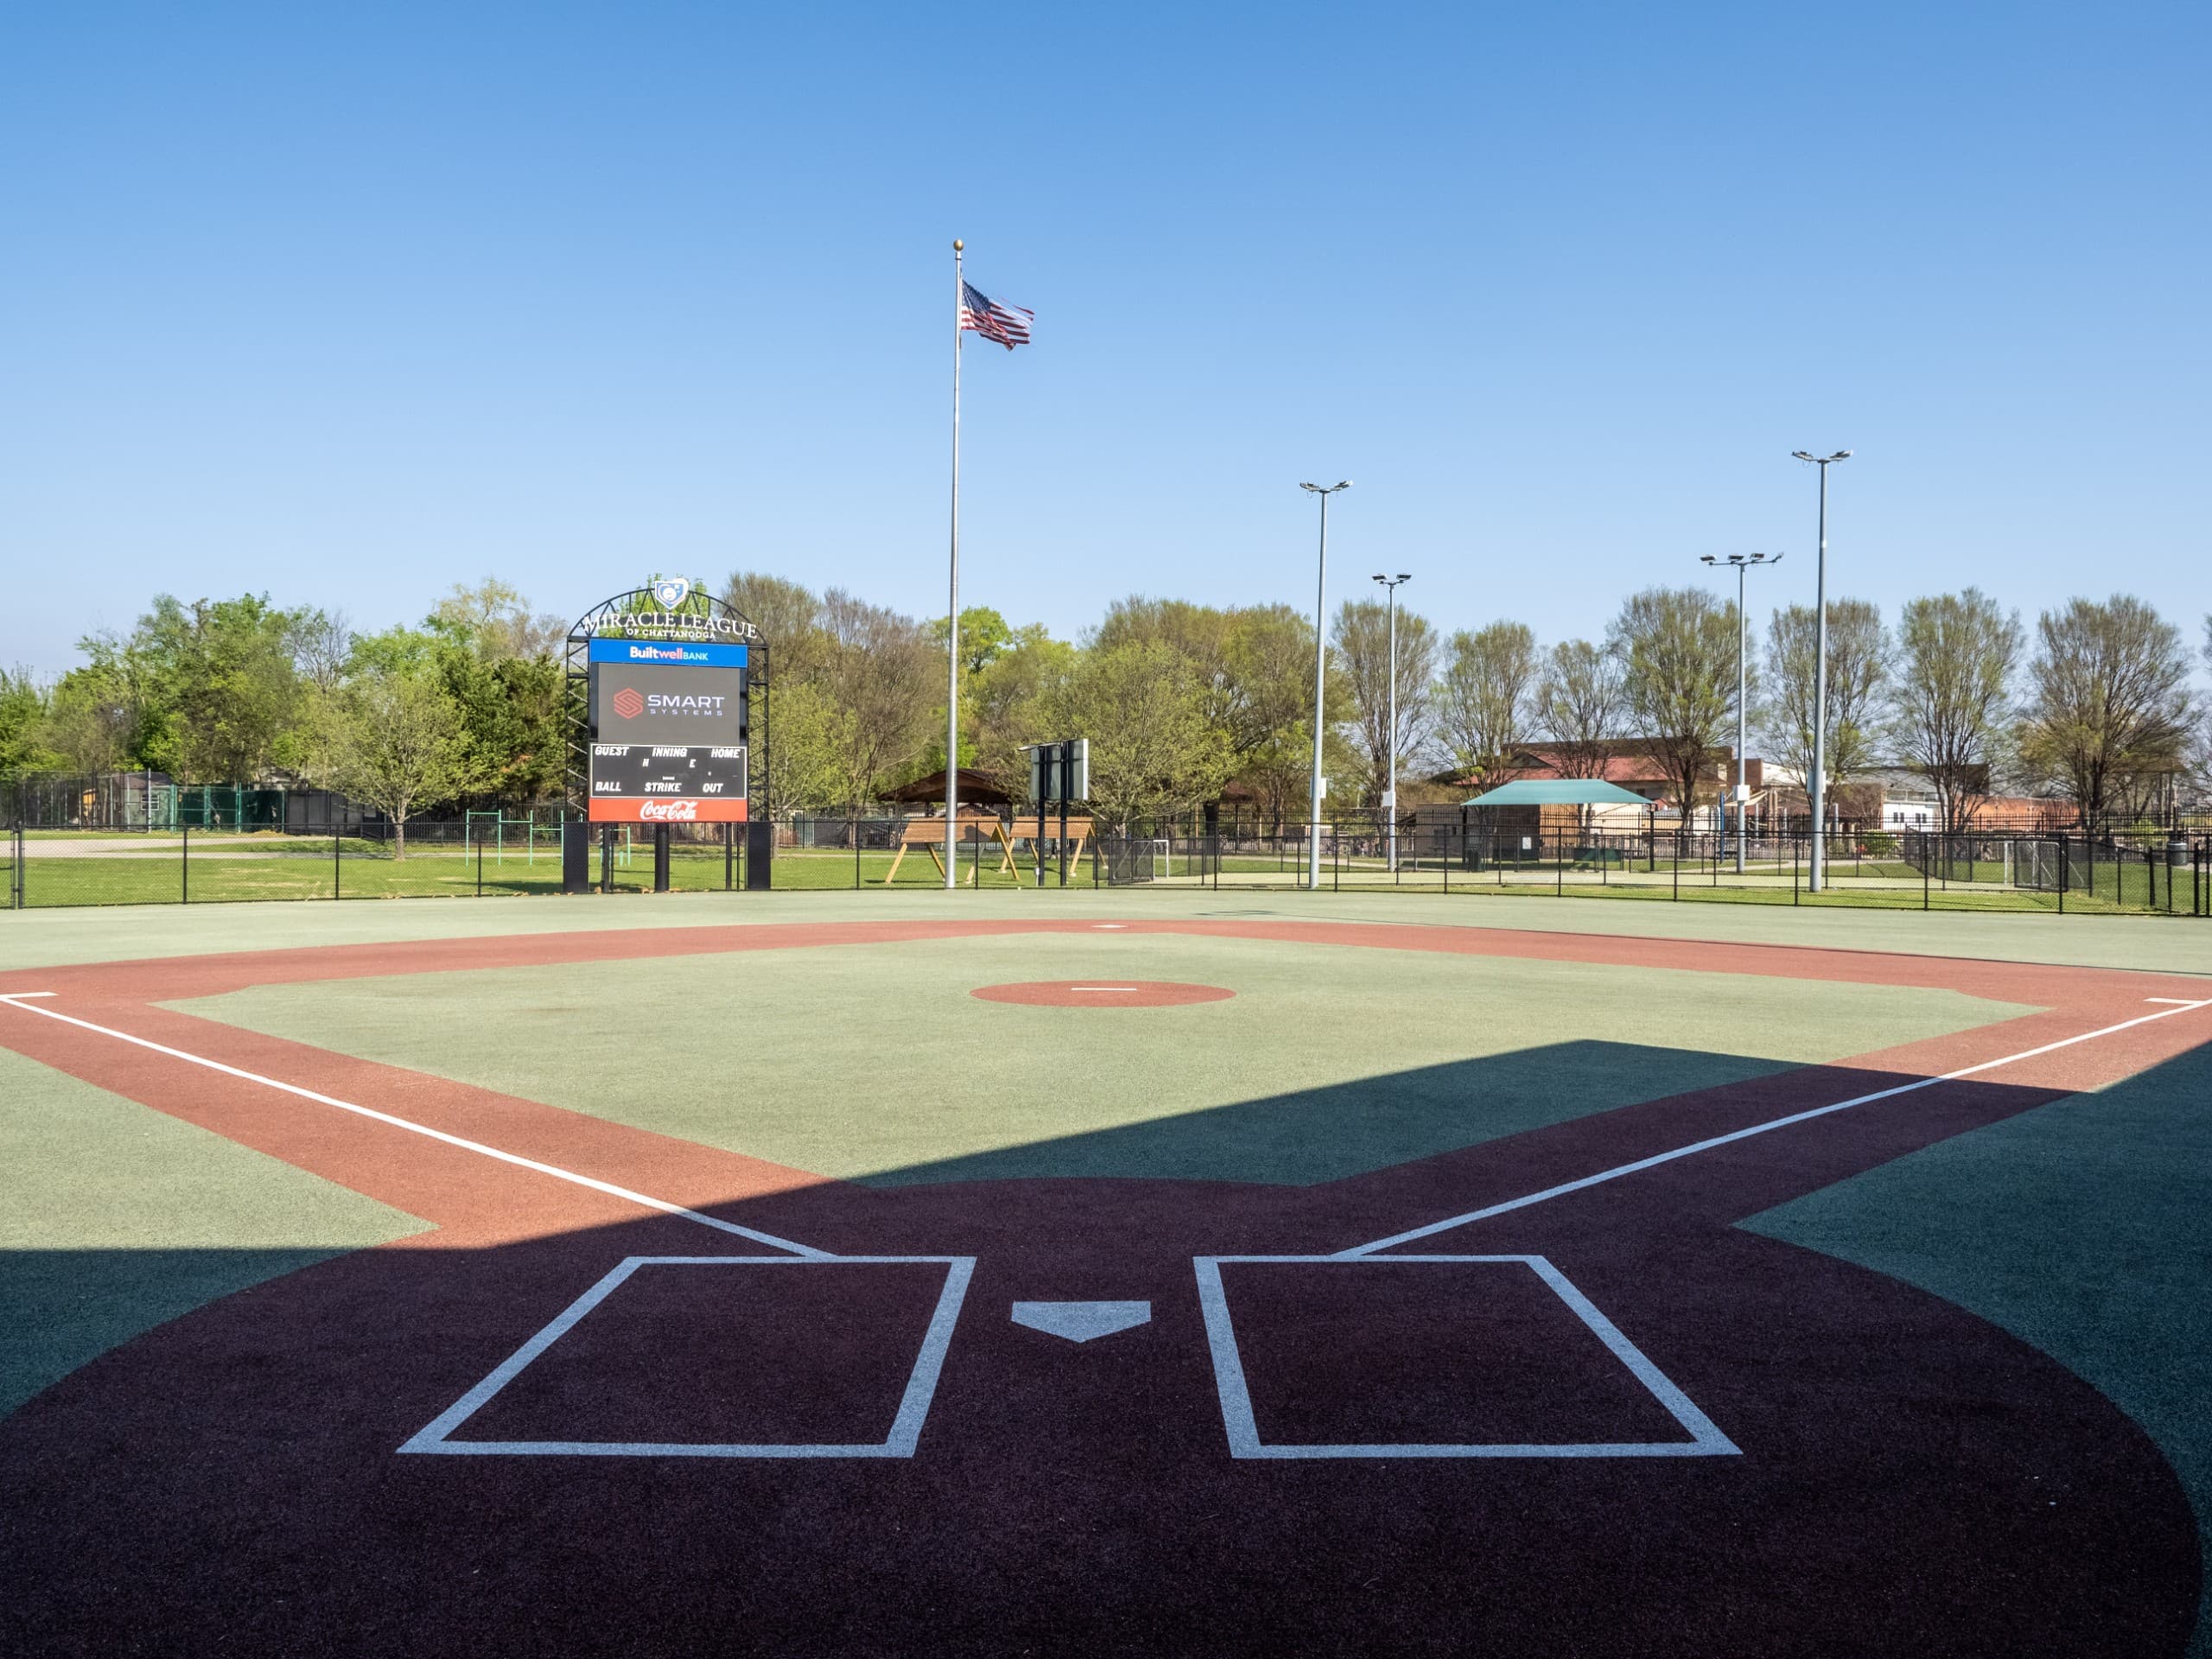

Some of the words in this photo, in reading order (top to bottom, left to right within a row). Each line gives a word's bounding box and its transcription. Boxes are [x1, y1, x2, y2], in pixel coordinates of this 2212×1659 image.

[583, 612, 680, 632] MIRACLE
[681, 614, 757, 639] LEAGUE
[642, 628, 715, 639] CHATTANOOGA
[648, 695, 725, 709] SMART
[594, 746, 629, 757] GUEST
[652, 747, 687, 758] INNING
[711, 748, 741, 759] HOME
[642, 759, 650, 767] H
[689, 759, 696, 768] E
[595, 781, 622, 791] BALL
[645, 782, 682, 792] STRIKE
[702, 783, 723, 793] OUT
